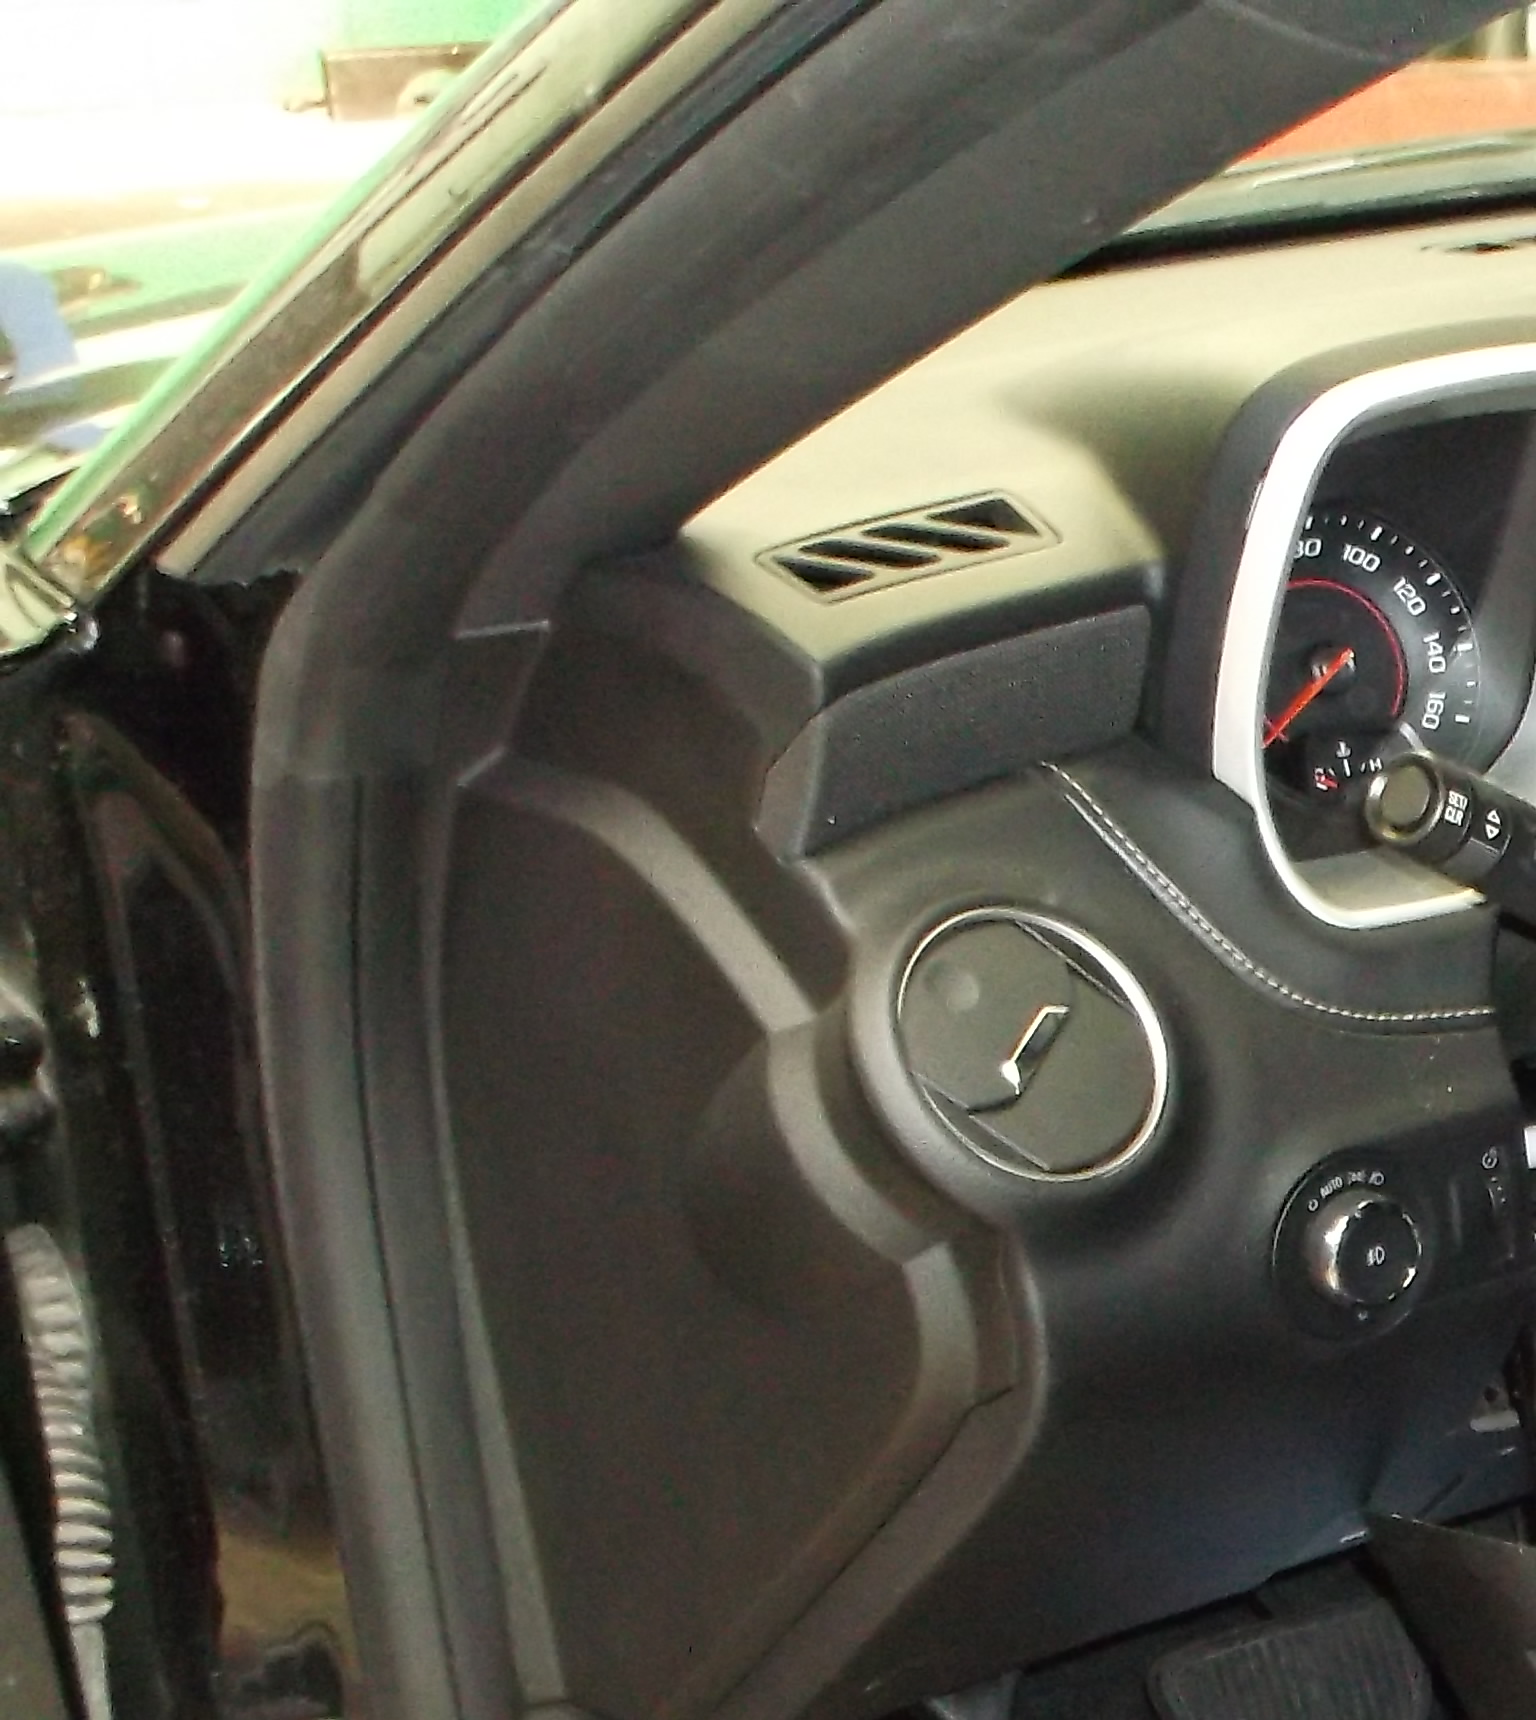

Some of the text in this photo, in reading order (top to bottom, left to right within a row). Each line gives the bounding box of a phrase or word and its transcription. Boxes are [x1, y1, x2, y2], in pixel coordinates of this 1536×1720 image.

[1342, 543, 1381, 573] 100
[1392, 576, 1427, 617] 120
[1423, 632, 1447, 674] 140
[1421, 691, 1446, 731] 160
[1369, 757, 1383, 773] H
[1444, 805, 1464, 827] CLR
[1320, 1176, 1343, 1199] AUTO
